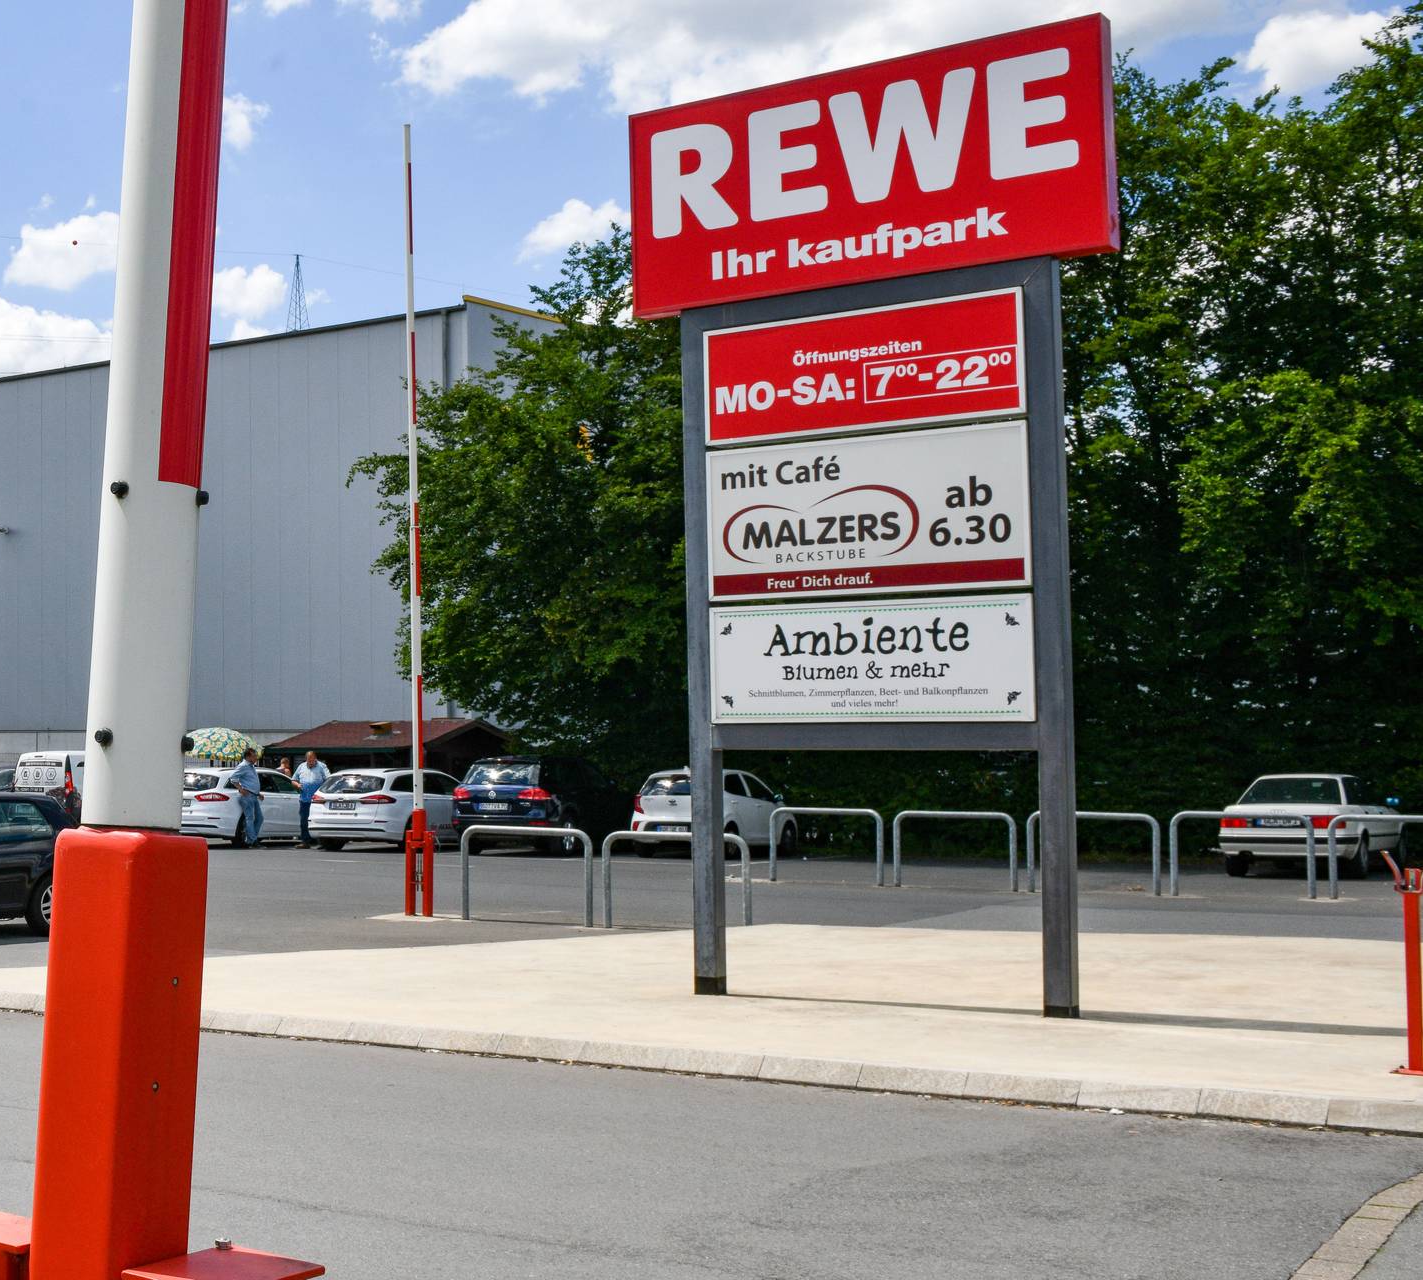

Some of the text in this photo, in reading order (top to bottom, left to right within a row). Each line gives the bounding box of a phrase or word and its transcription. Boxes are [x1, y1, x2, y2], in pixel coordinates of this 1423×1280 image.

[650, 47, 1080, 240] REWE
[711, 206, 1009, 281] Ihr kaufpark
[792, 338, 922, 367] Öffnungszeiten
[715, 372, 856, 416] MO-SA:
[720, 455, 841, 491] mit Café
[944, 475, 993, 509] ab
[742, 511, 902, 550] MALZERS
[928, 513, 1012, 547] 6.30
[775, 548, 867, 565] BACKSTUBE
[802, 574, 831, 588] Dich
[834, 572, 874, 586] drauf.
[763, 616, 970, 657] Ambiente
[781, 661, 951, 681] Blumen & mehr
[747, 686, 989, 699] Schnittblumen, Zimmerpflanzen, Beet- und Balkonpflanzen
[830, 698, 898, 708] und vieles mehr!
